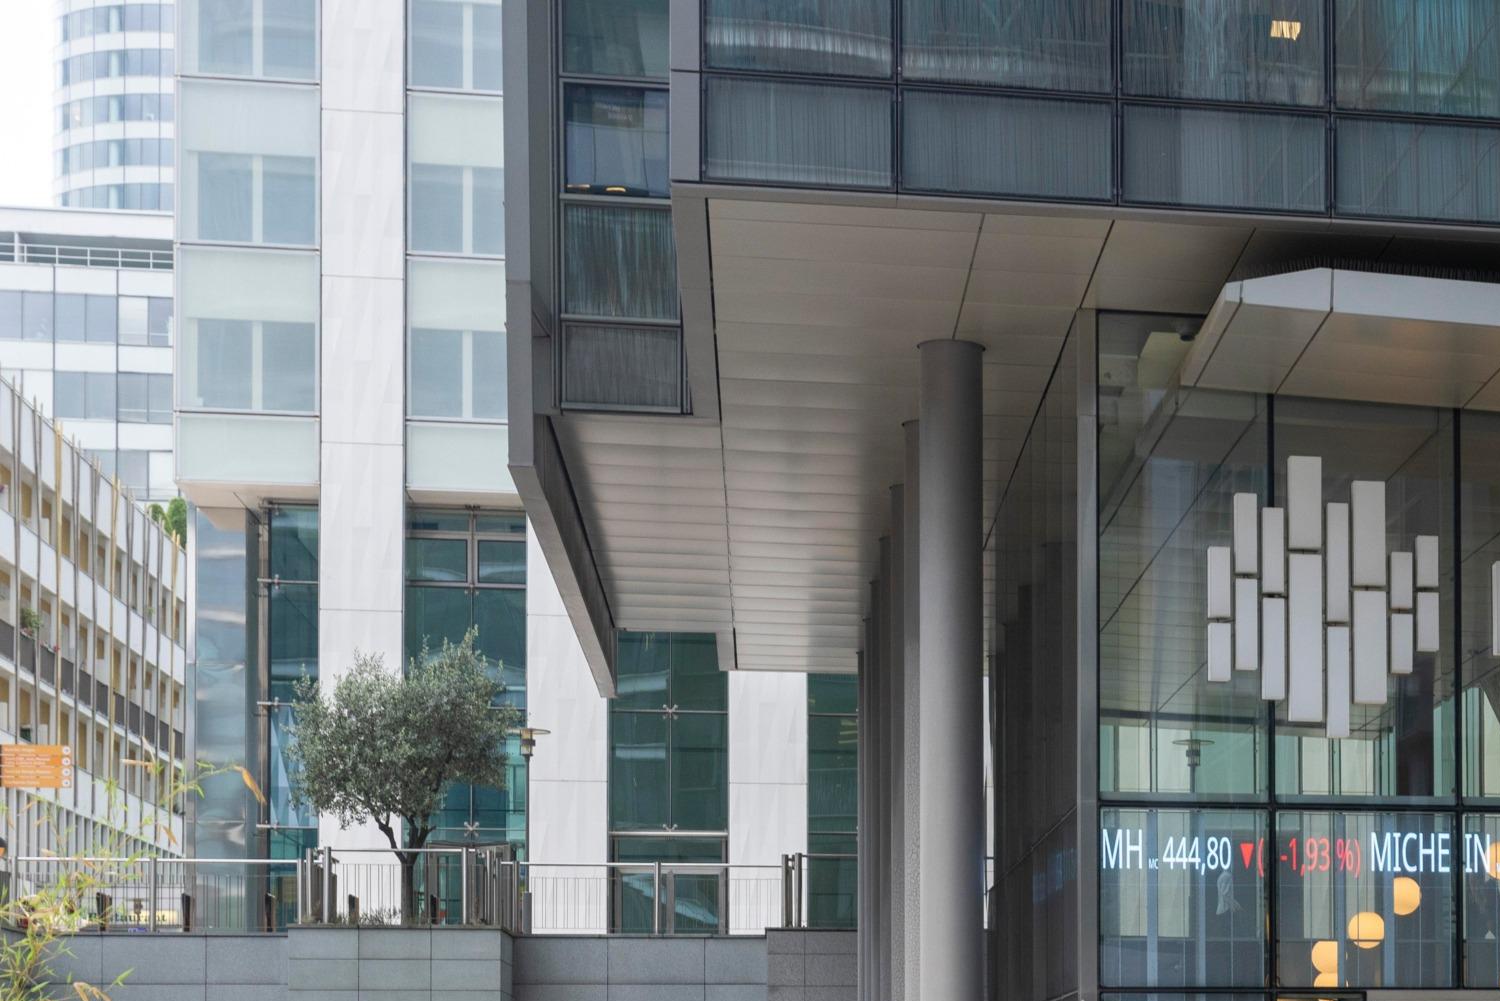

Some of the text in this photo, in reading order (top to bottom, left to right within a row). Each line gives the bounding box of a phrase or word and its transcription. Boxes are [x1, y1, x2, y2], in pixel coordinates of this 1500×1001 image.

[1102, 829, 1143, 870] MH
[1162, 836, 1232, 876] 444,80
[1370, 832, 1490, 874] MICHEIN
